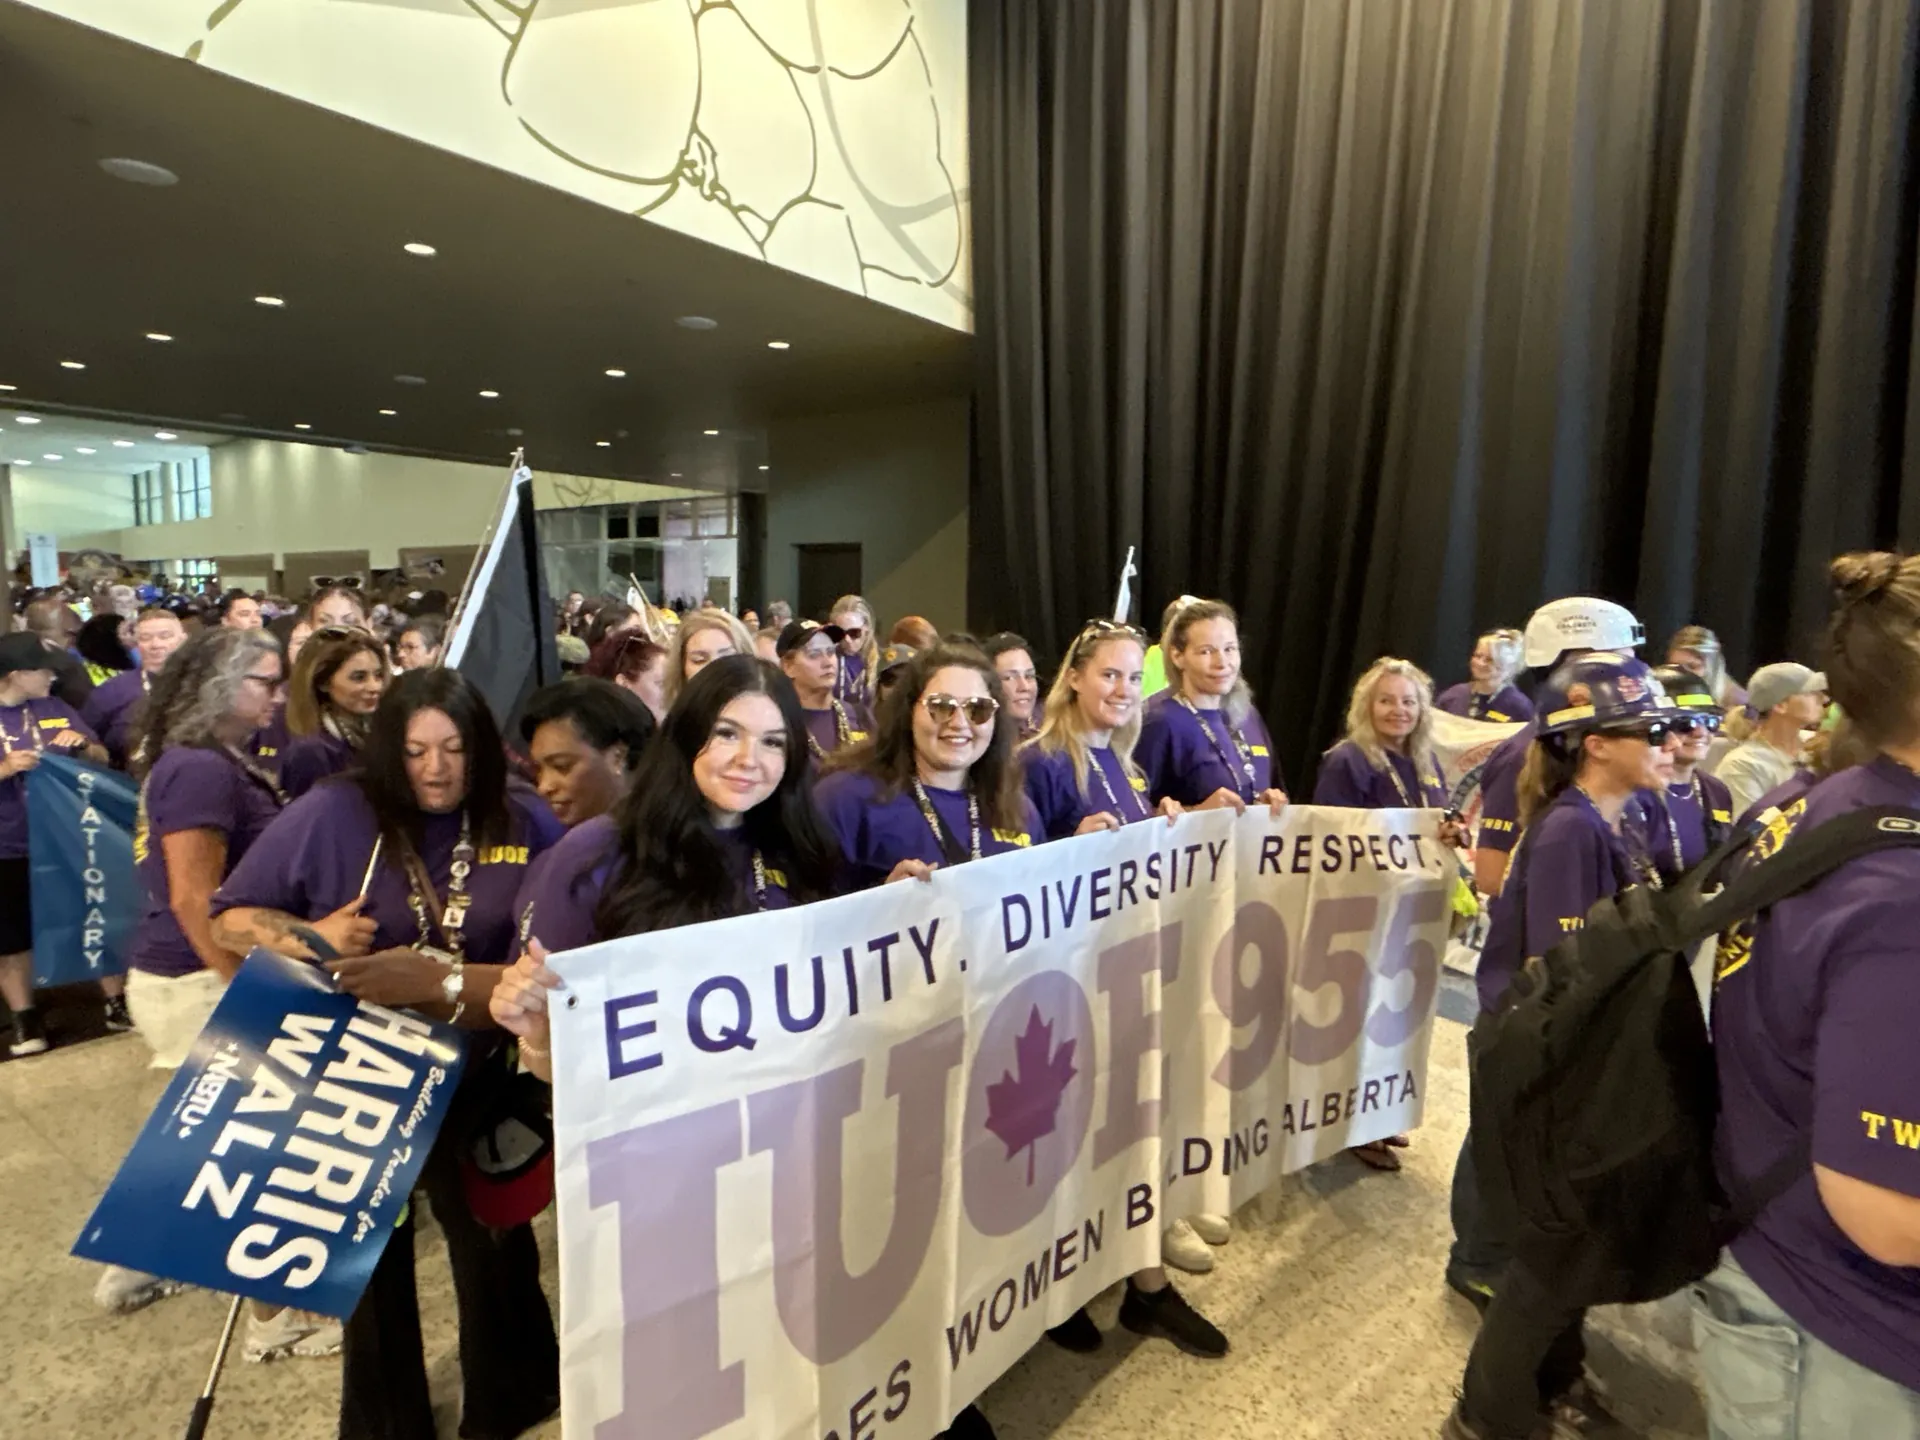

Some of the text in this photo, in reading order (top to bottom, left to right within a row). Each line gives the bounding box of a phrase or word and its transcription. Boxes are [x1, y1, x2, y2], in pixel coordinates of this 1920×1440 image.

[78, 772, 105, 969] STATIONARY
[604, 917, 967, 1080] EQUITY.
[1259, 834, 1442, 876] RESPECT.
[1211, 890, 1448, 1092] 955
[181, 1013, 335, 1220] WALZ
[226, 1000, 432, 1289] HARRIS
[352, 1066, 446, 1243] Building Trades for
[823, 1360, 911, 1440] ES
[945, 1210, 1105, 1372] WOMEN
[1282, 1070, 1418, 1135] ALBERTA
